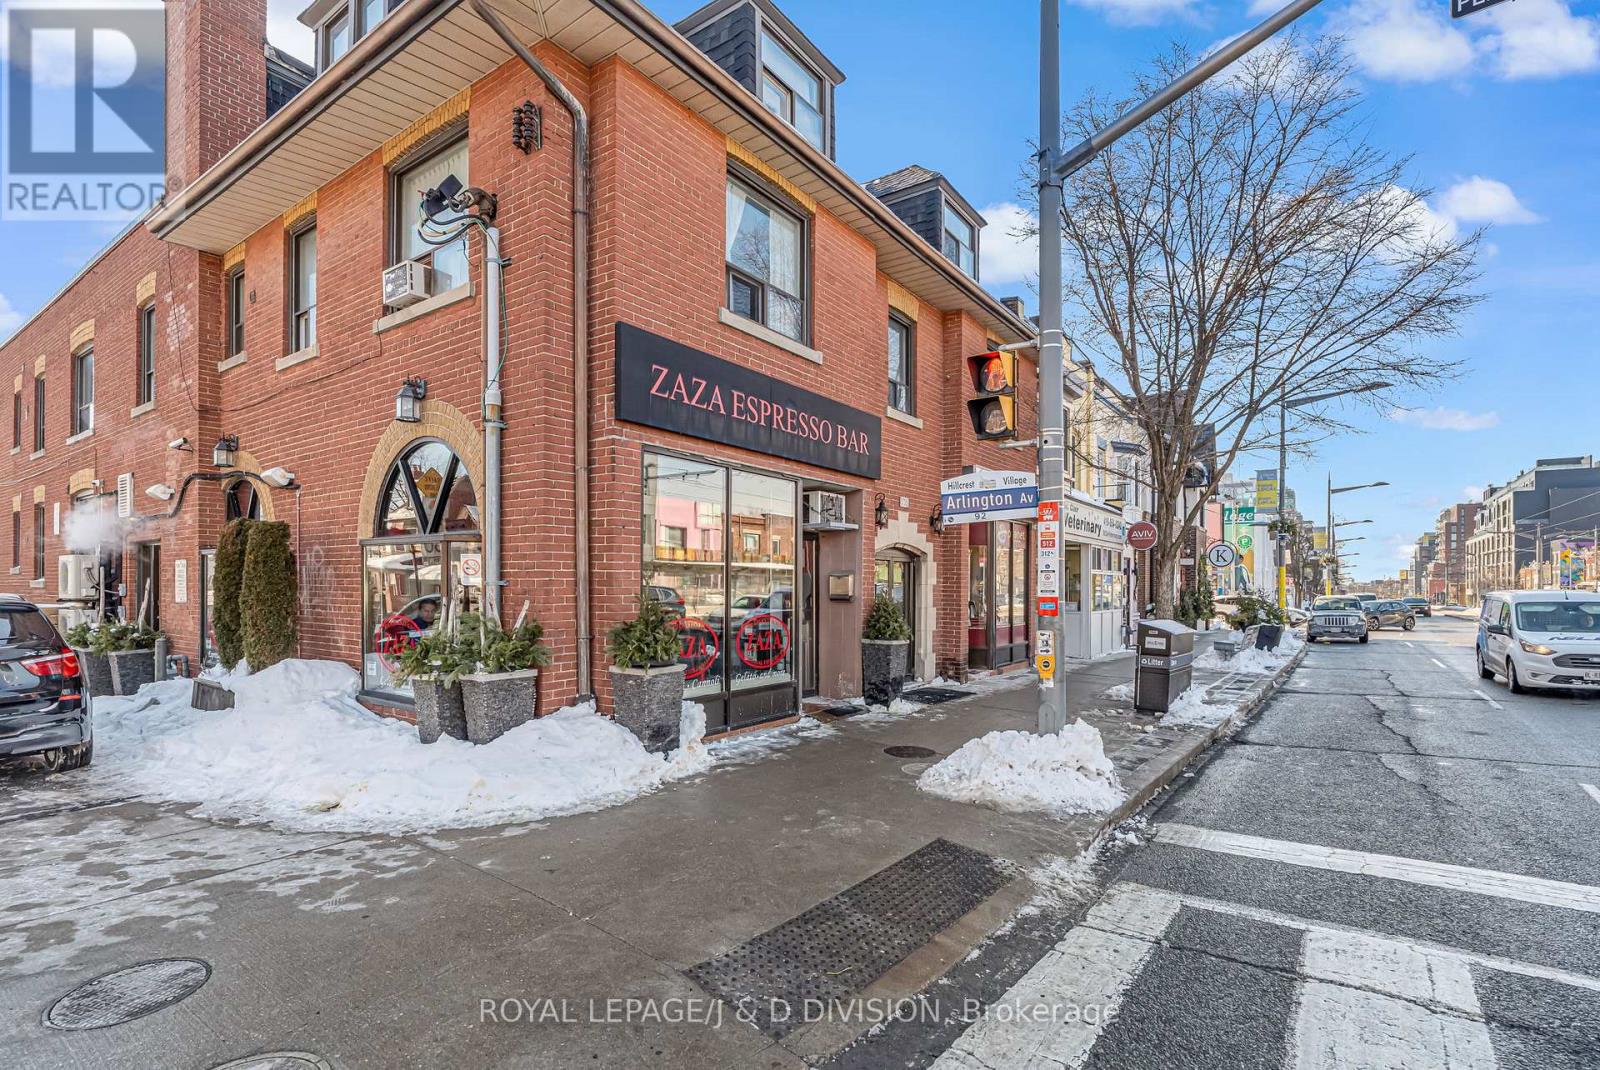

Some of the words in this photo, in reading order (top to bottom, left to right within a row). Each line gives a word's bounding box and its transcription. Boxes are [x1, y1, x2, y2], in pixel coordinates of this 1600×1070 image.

[650, 364, 726, 415] ZAZA
[731, 390, 832, 444] ESPRESSO
[836, 425, 870, 456] BAR
[947, 481, 976, 490] Hillcrest
[1002, 476, 1027, 486] Village
[946, 493, 1013, 511] Arlington
[1020, 492, 1034, 504] Av
[974, 513, 987, 521] 92
[1131, 530, 1154, 538] AVIV
[1216, 550, 1228, 562] K
[746, 630, 783, 652] ZAZA
[1147, 658, 1164, 667] Litter
